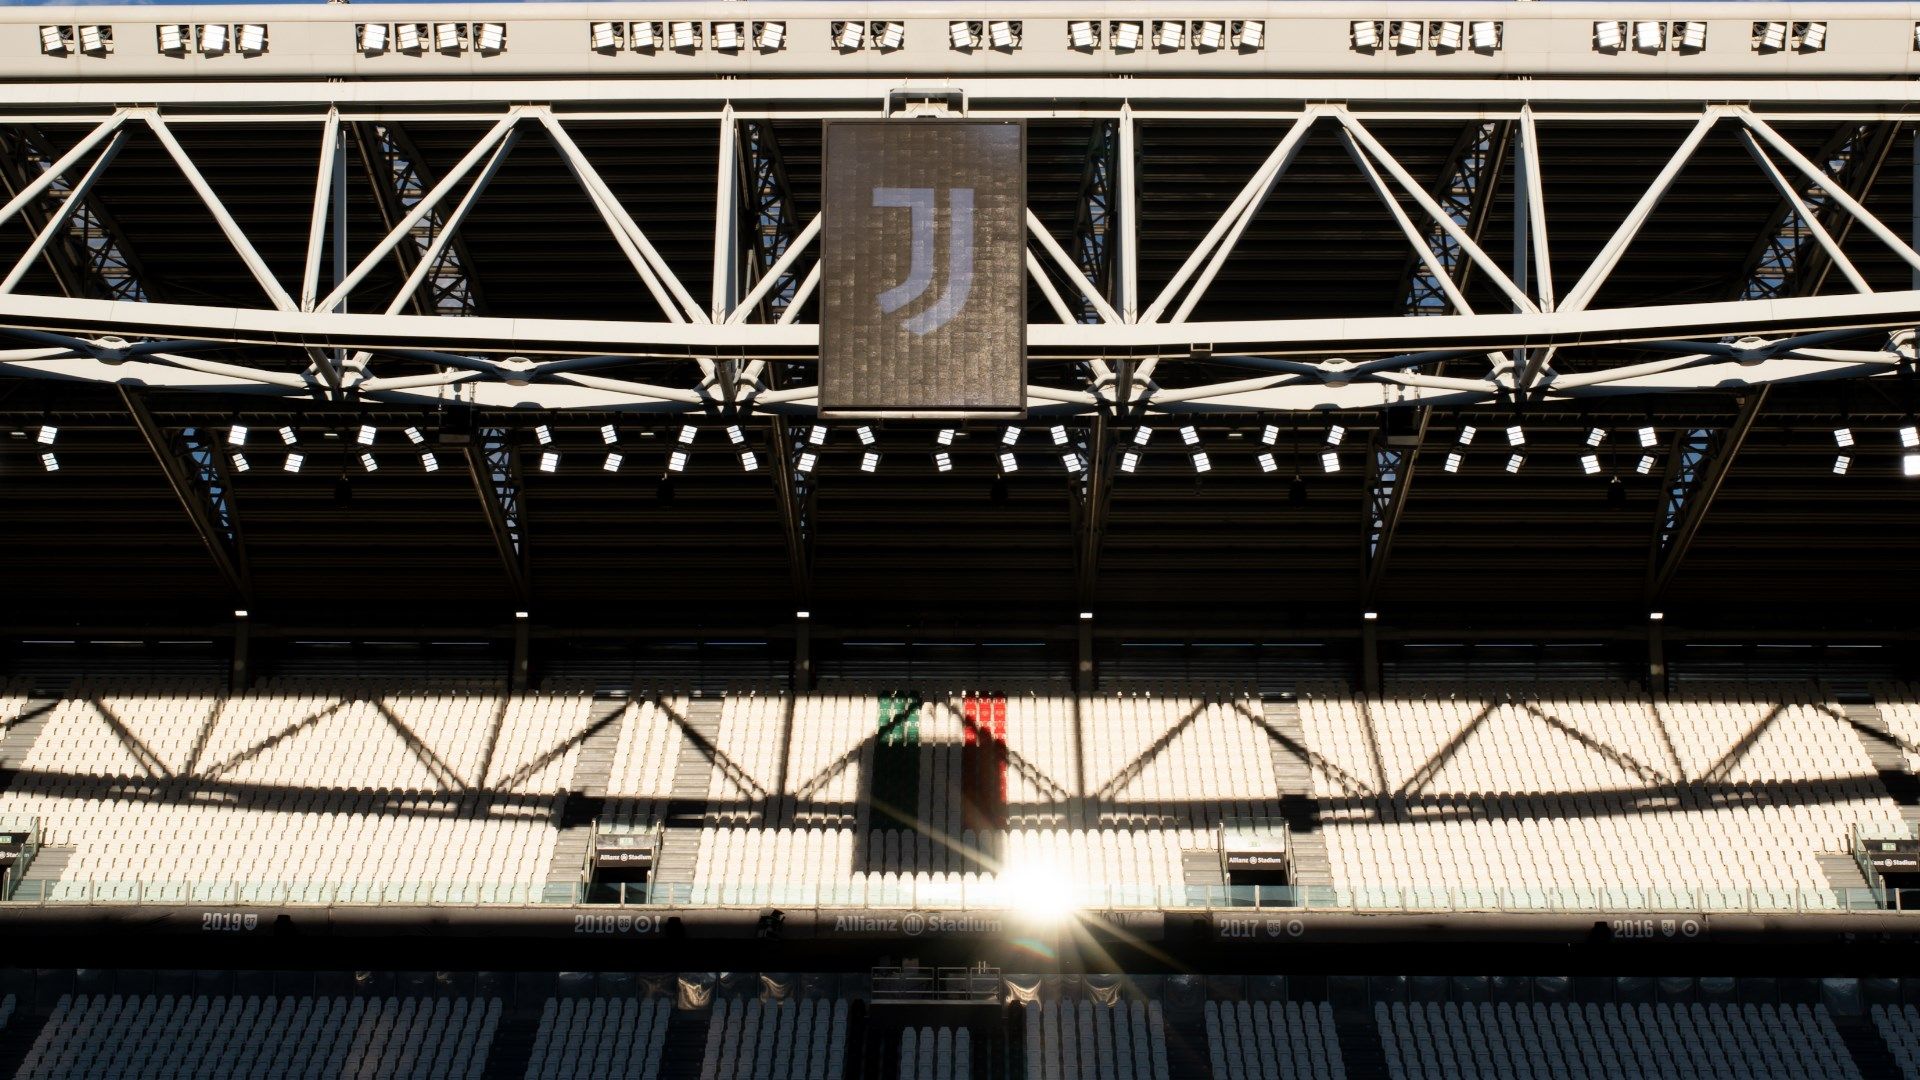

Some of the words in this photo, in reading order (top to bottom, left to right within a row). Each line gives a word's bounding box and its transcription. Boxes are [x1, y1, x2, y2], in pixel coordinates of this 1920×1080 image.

[202, 912, 242, 931] 2019
[246, 917, 256, 926] 37
[574, 915, 615, 933] 2018
[619, 918, 630, 928] 36
[834, 914, 898, 932] Allianz
[928, 914, 1002, 932] Stadium
[1220, 919, 1259, 937] 2017
[1268, 922, 1280, 933] 35
[1613, 919, 1654, 938] 2016
[1663, 923, 1674, 932] 34
